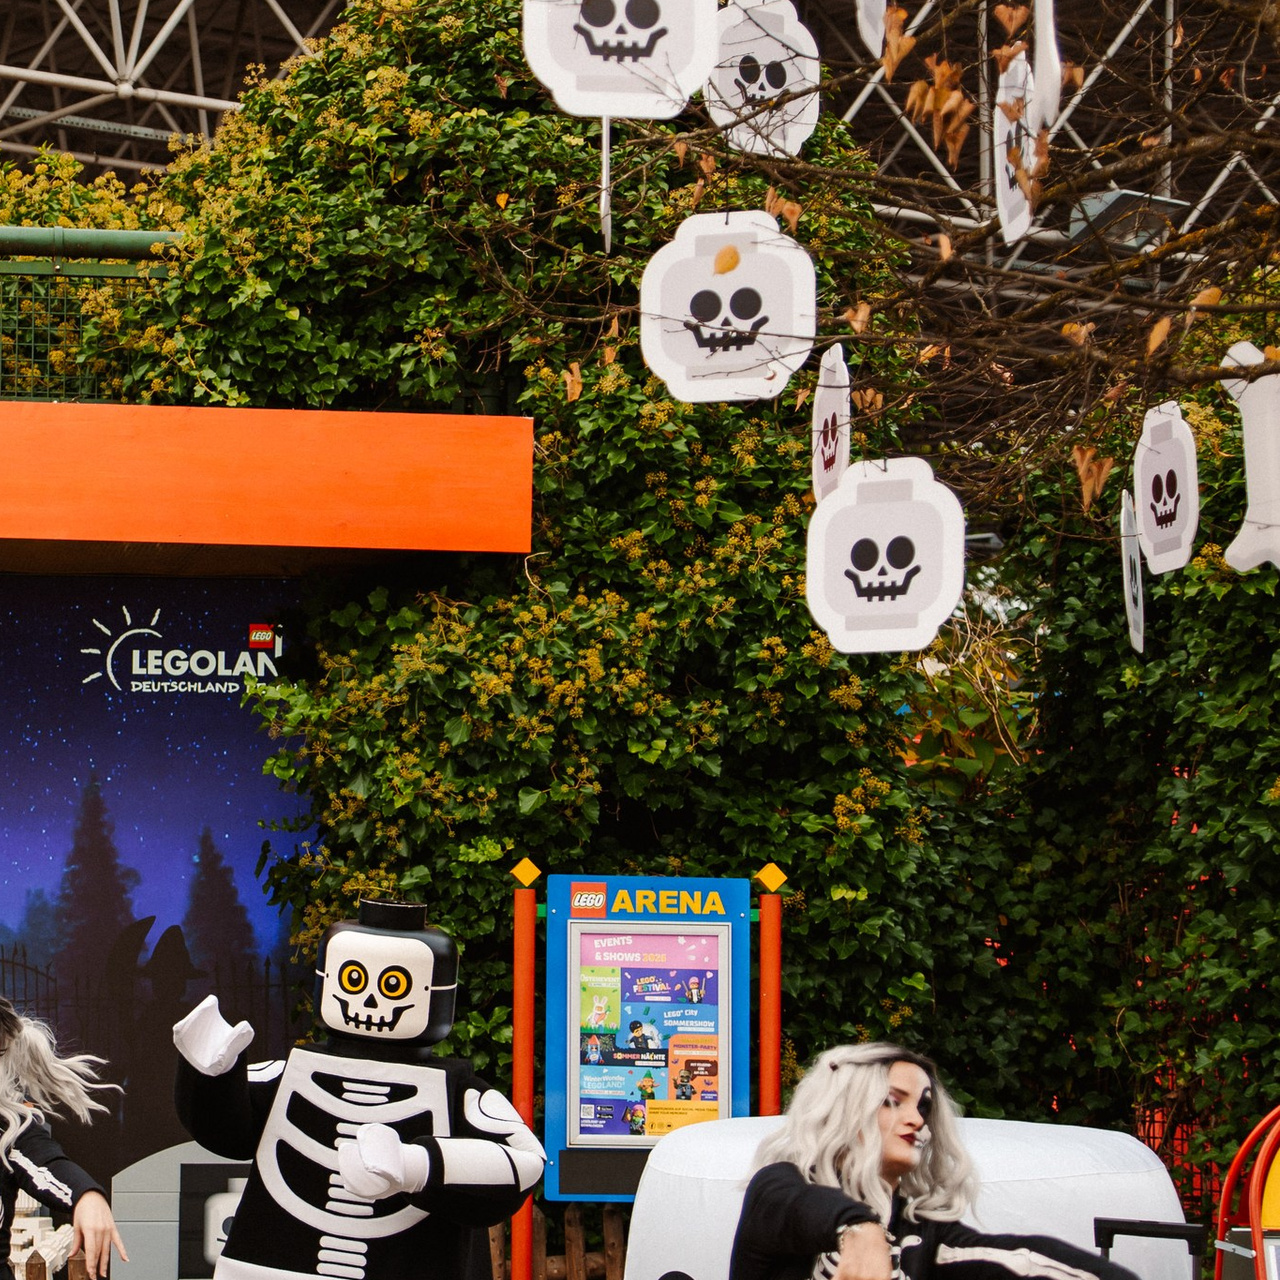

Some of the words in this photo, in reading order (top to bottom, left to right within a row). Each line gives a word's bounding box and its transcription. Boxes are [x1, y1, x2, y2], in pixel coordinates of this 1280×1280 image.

[251, 631, 273, 641] LEGO
[131, 649, 281, 677] LEGOLAN
[130, 680, 240, 694] DEUTSCHLAND
[573, 892, 605, 908] LEGO
[611, 890, 726, 915] ARENA
[594, 936, 632, 948] EVENTS
[595, 952, 602, 961] &
[603, 952, 641, 962] SHOWS
[633, 982, 672, 993] FESTIVAL
